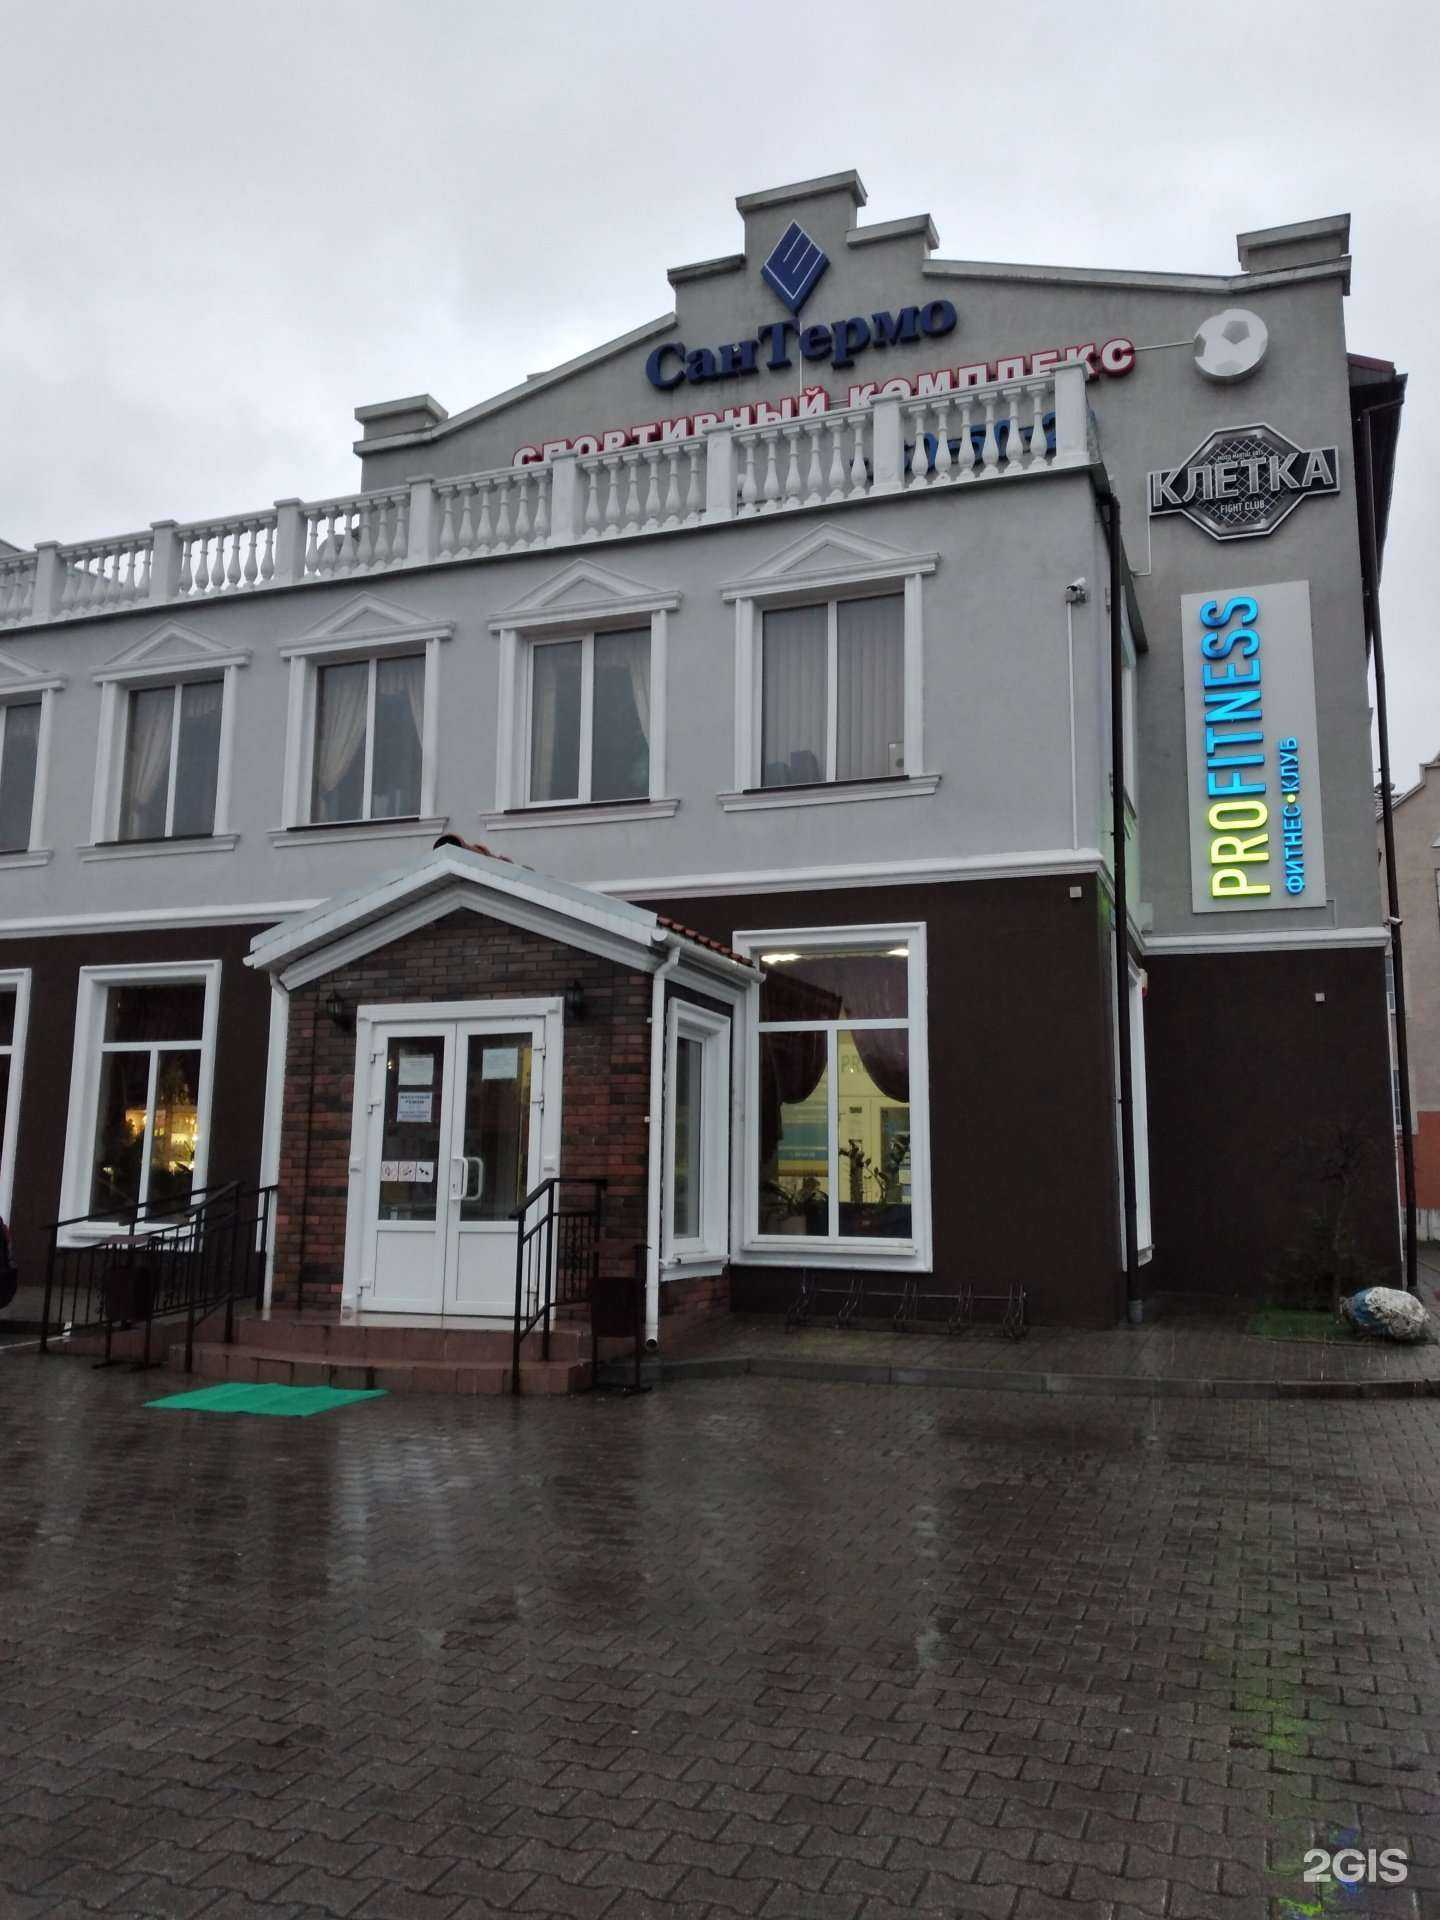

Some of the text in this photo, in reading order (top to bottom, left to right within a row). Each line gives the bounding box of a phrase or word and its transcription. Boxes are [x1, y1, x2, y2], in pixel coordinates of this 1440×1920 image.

[646, 300, 958, 390] СанТермо
[1152, 450, 1335, 507] КЛЕТКА
[1220, 499, 1265, 514] FIGHT CLUB
[1200, 596, 1271, 898] PROFITNESS
